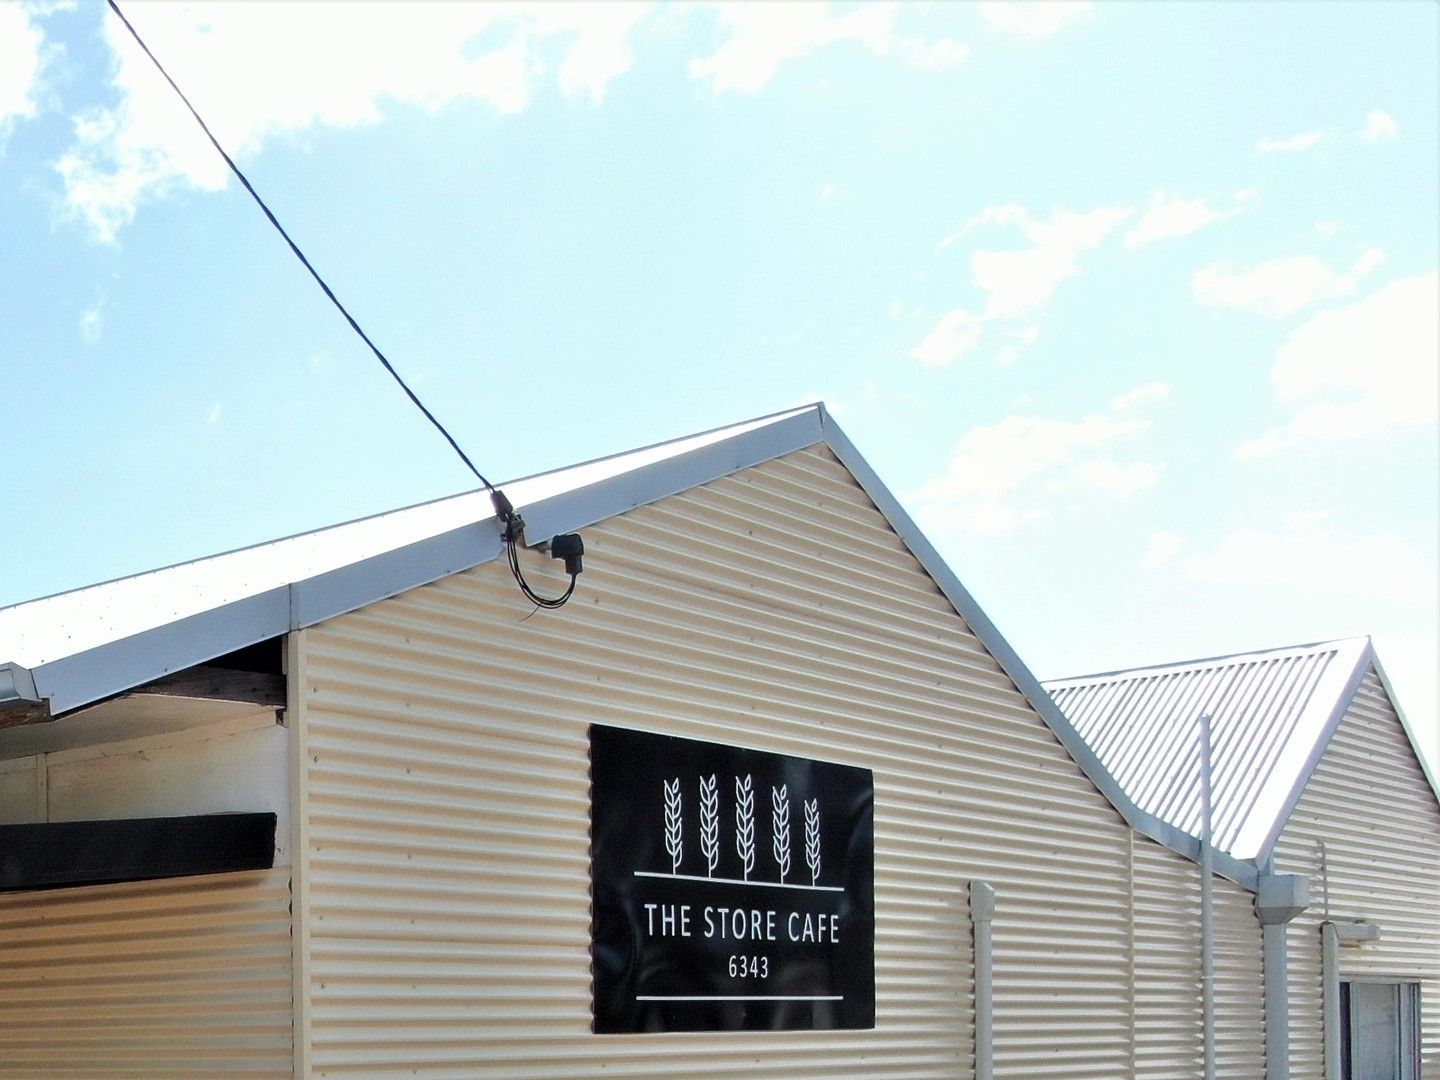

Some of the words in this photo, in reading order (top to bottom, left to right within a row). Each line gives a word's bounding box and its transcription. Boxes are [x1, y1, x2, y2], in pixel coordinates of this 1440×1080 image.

[644, 904, 692, 937] THE
[704, 906, 777, 941] STORE
[788, 912, 840, 943] CAFE
[728, 955, 769, 979] 6343
